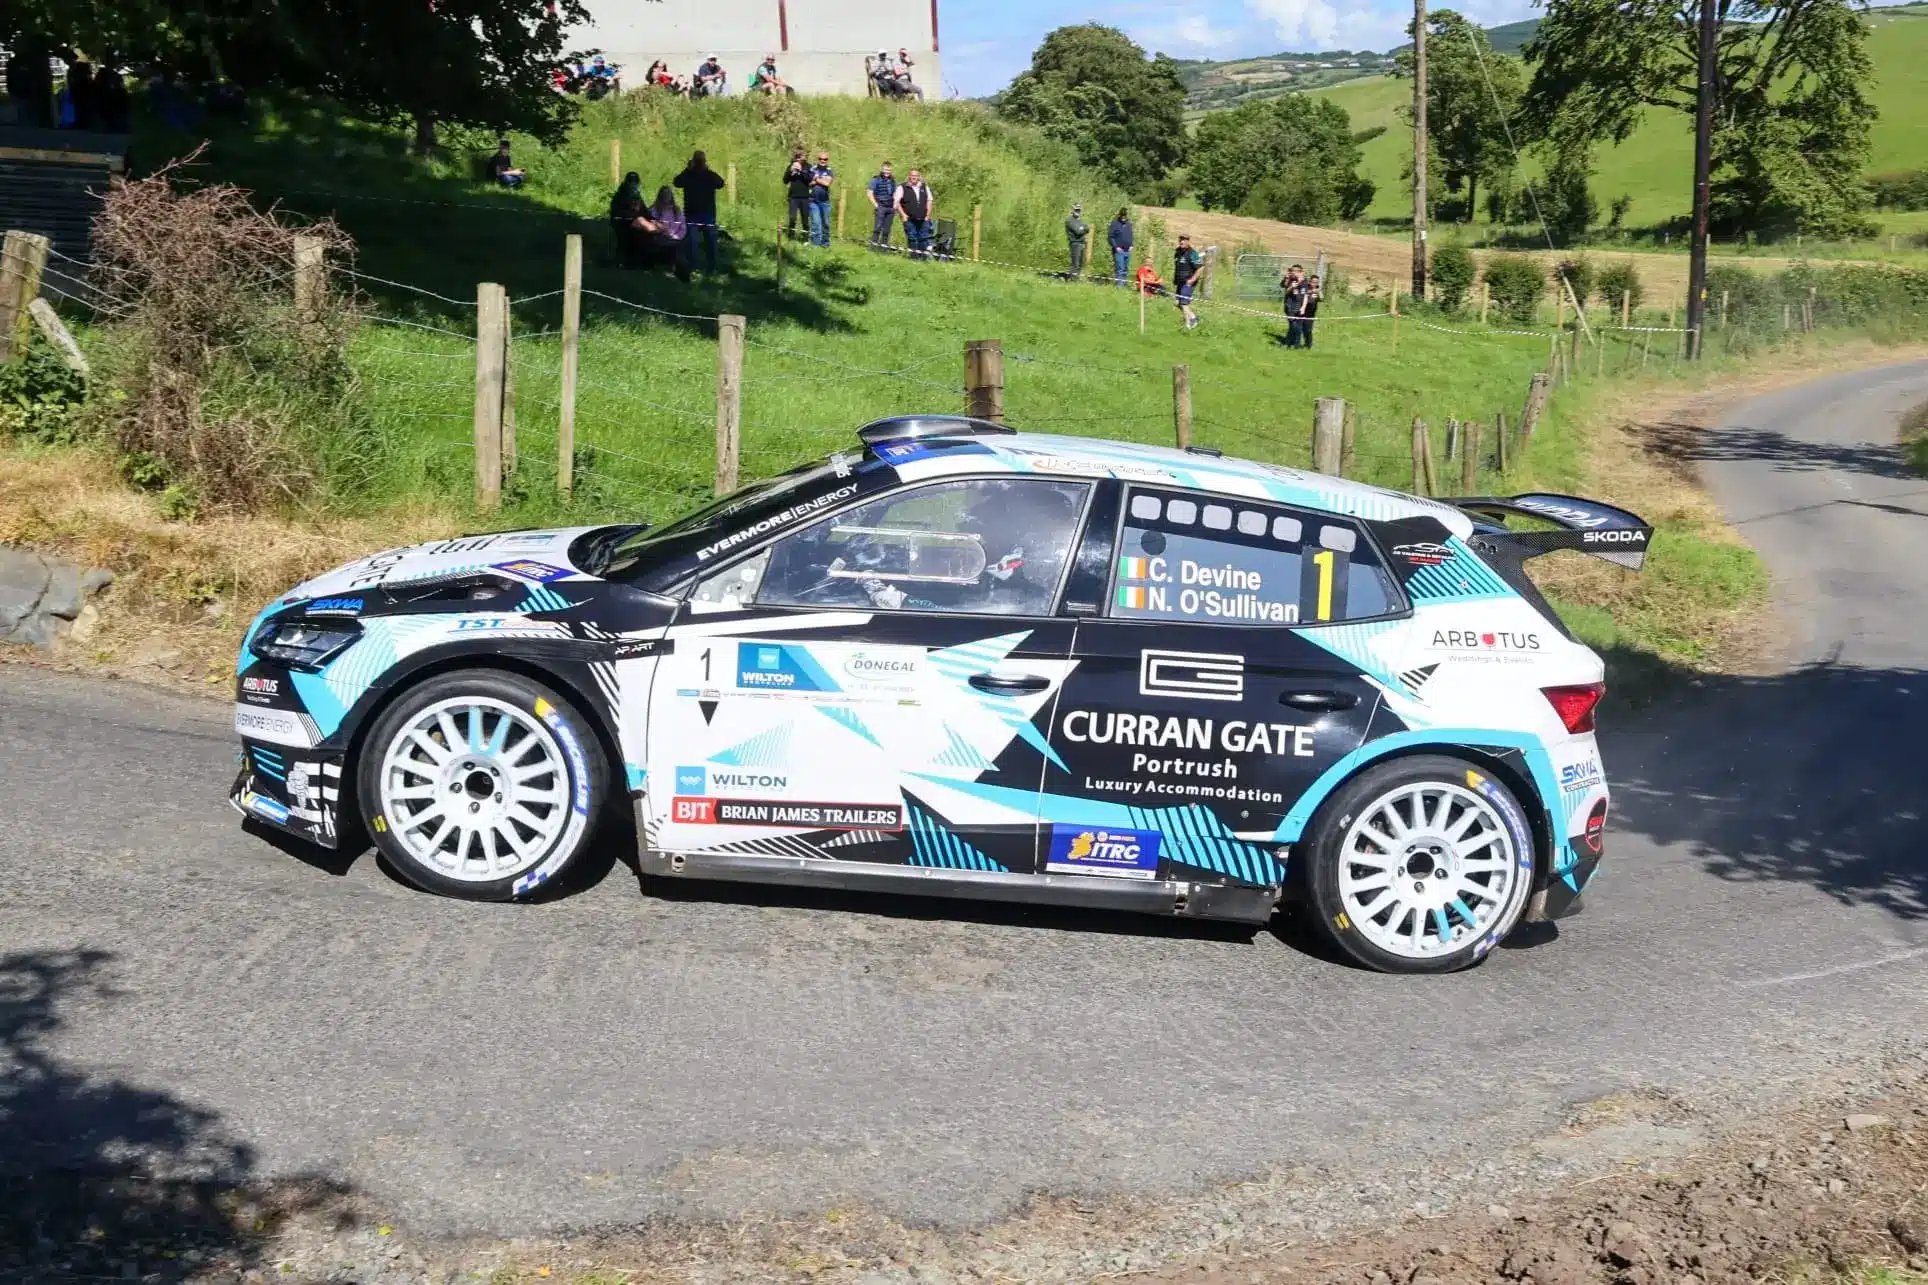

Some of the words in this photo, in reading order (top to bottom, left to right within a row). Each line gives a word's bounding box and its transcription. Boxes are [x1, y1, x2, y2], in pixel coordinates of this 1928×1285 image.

[696, 511, 793, 561] EVERMORE
[798, 482, 859, 515] ENERGY
[1148, 558, 1173, 583] C.
[1180, 560, 1262, 591] Devine
[1313, 550, 1334, 621] 1
[1148, 588, 1173, 612] N.
[1180, 589, 1299, 623] O'Sullivan
[457, 618, 504, 629] TST
[700, 647, 711, 681] 1
[742, 671, 794, 683] WILTON
[854, 660, 916, 672] DONEGAL
[1062, 710, 1213, 750] CURRAN
[1220, 721, 1315, 757] GATE
[1133, 753, 1238, 779] Portrush
[712, 773, 787, 788] WILTON
[1085, 776, 1143, 795] Luxury
[1146, 780, 1283, 803] Accommodation
[677, 801, 711, 819] BJT
[721, 805, 768, 820] BRIAN
[772, 807, 820, 822] JAMES
[824, 809, 897, 824] TRAILERS
[1091, 842, 1141, 860] ITRC
